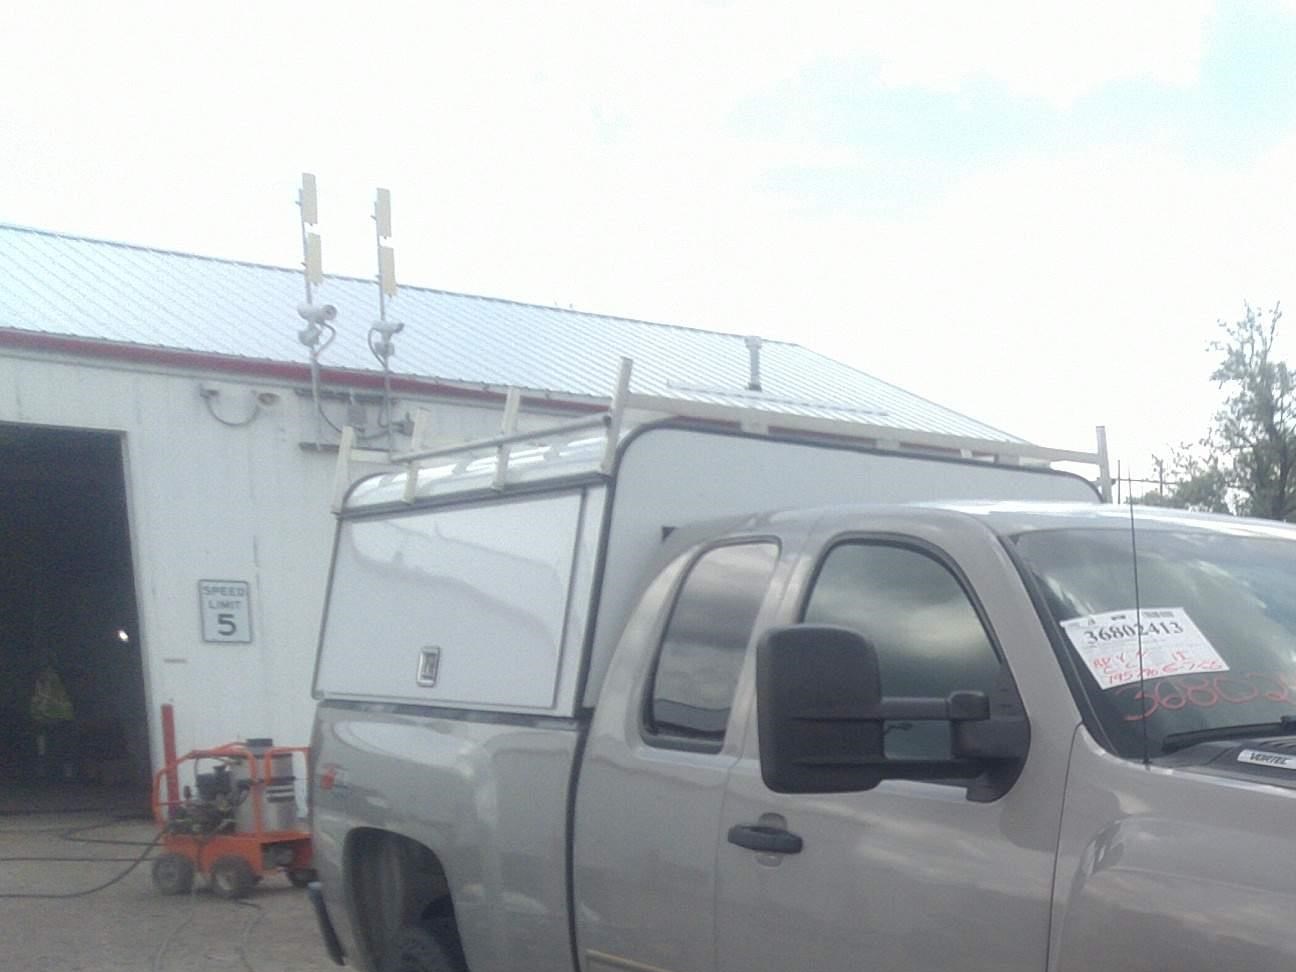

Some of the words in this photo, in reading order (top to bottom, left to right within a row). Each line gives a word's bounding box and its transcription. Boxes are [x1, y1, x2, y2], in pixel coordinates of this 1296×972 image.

[202, 586, 245, 597] SPEED
[208, 600, 241, 609] LIMIT
[217, 613, 237, 636] 5
[1084, 621, 1184, 646] 36802413
